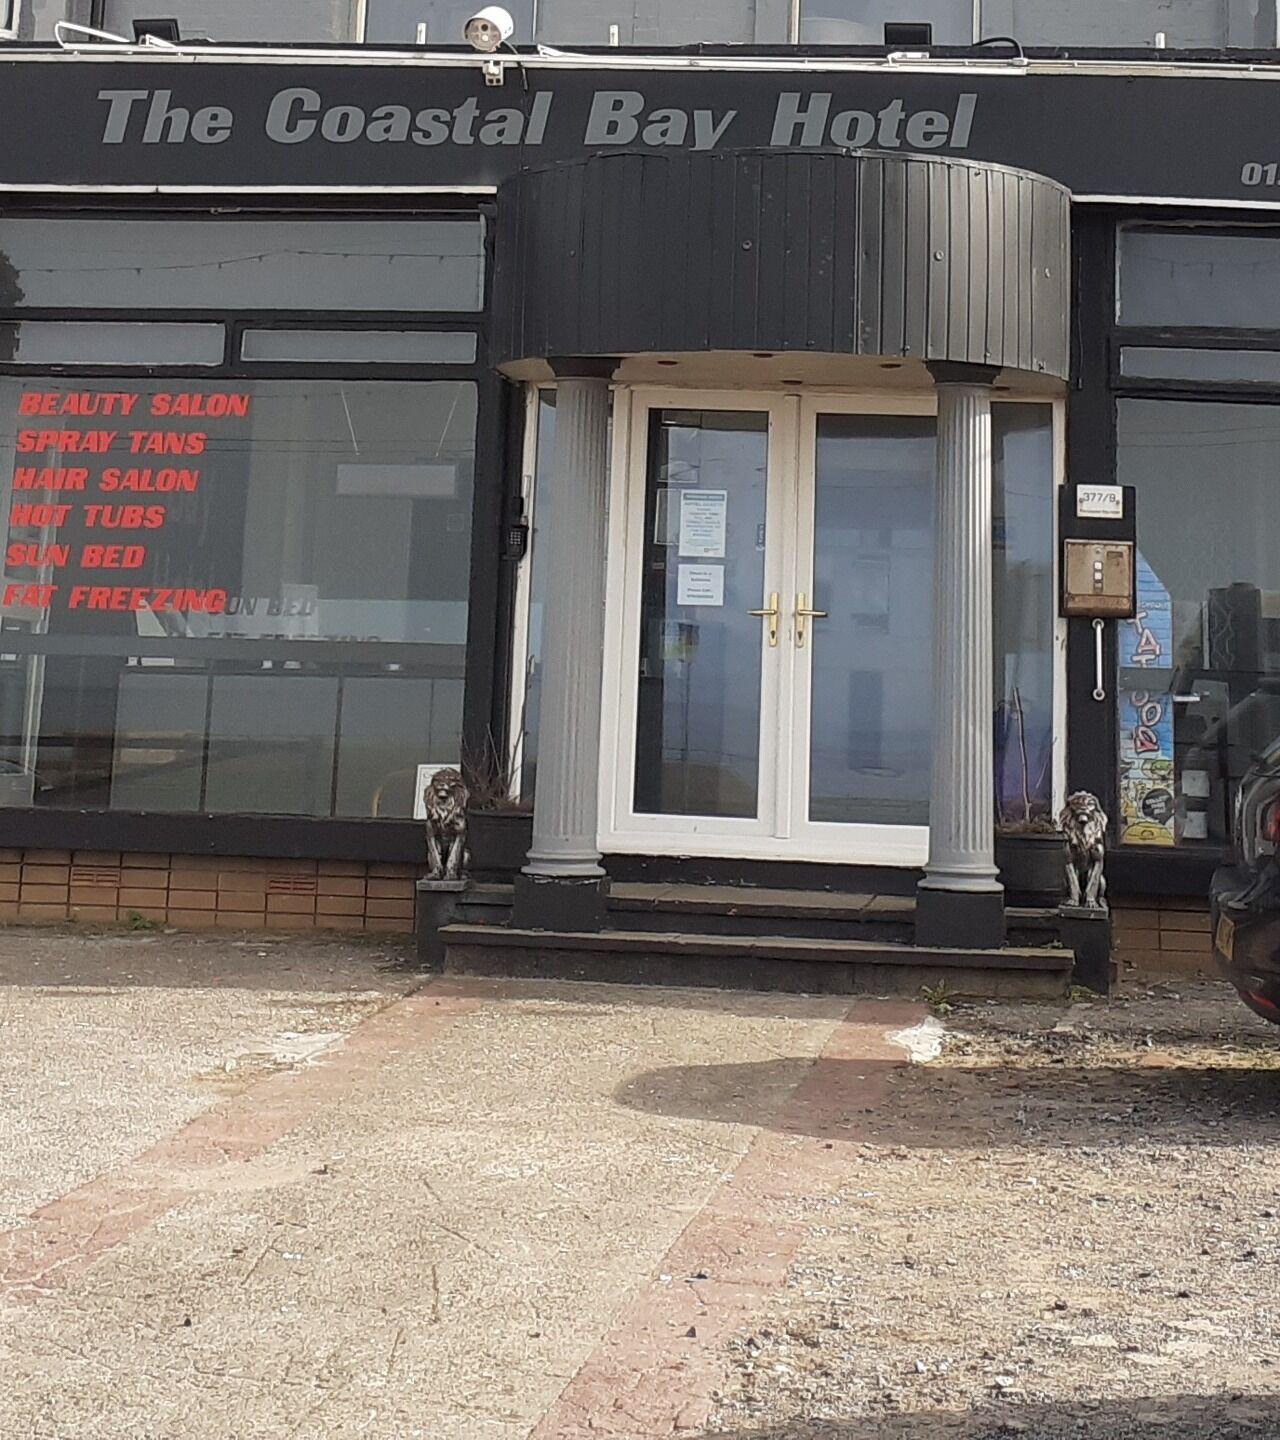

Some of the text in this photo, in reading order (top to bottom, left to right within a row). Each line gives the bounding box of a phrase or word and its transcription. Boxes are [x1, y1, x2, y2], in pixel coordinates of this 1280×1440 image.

[98, 87, 978, 151] The Coastal Bay Hotel
[17, 392, 251, 417] BEAUTY SALON
[16, 430, 208, 454] SPRAY TANS
[12, 467, 200, 492] HAIR SALON
[8, 504, 166, 529] HOT TUBS
[4, 544, 146, 569] SUN BED
[2, 584, 227, 613] FAT FREEZING
